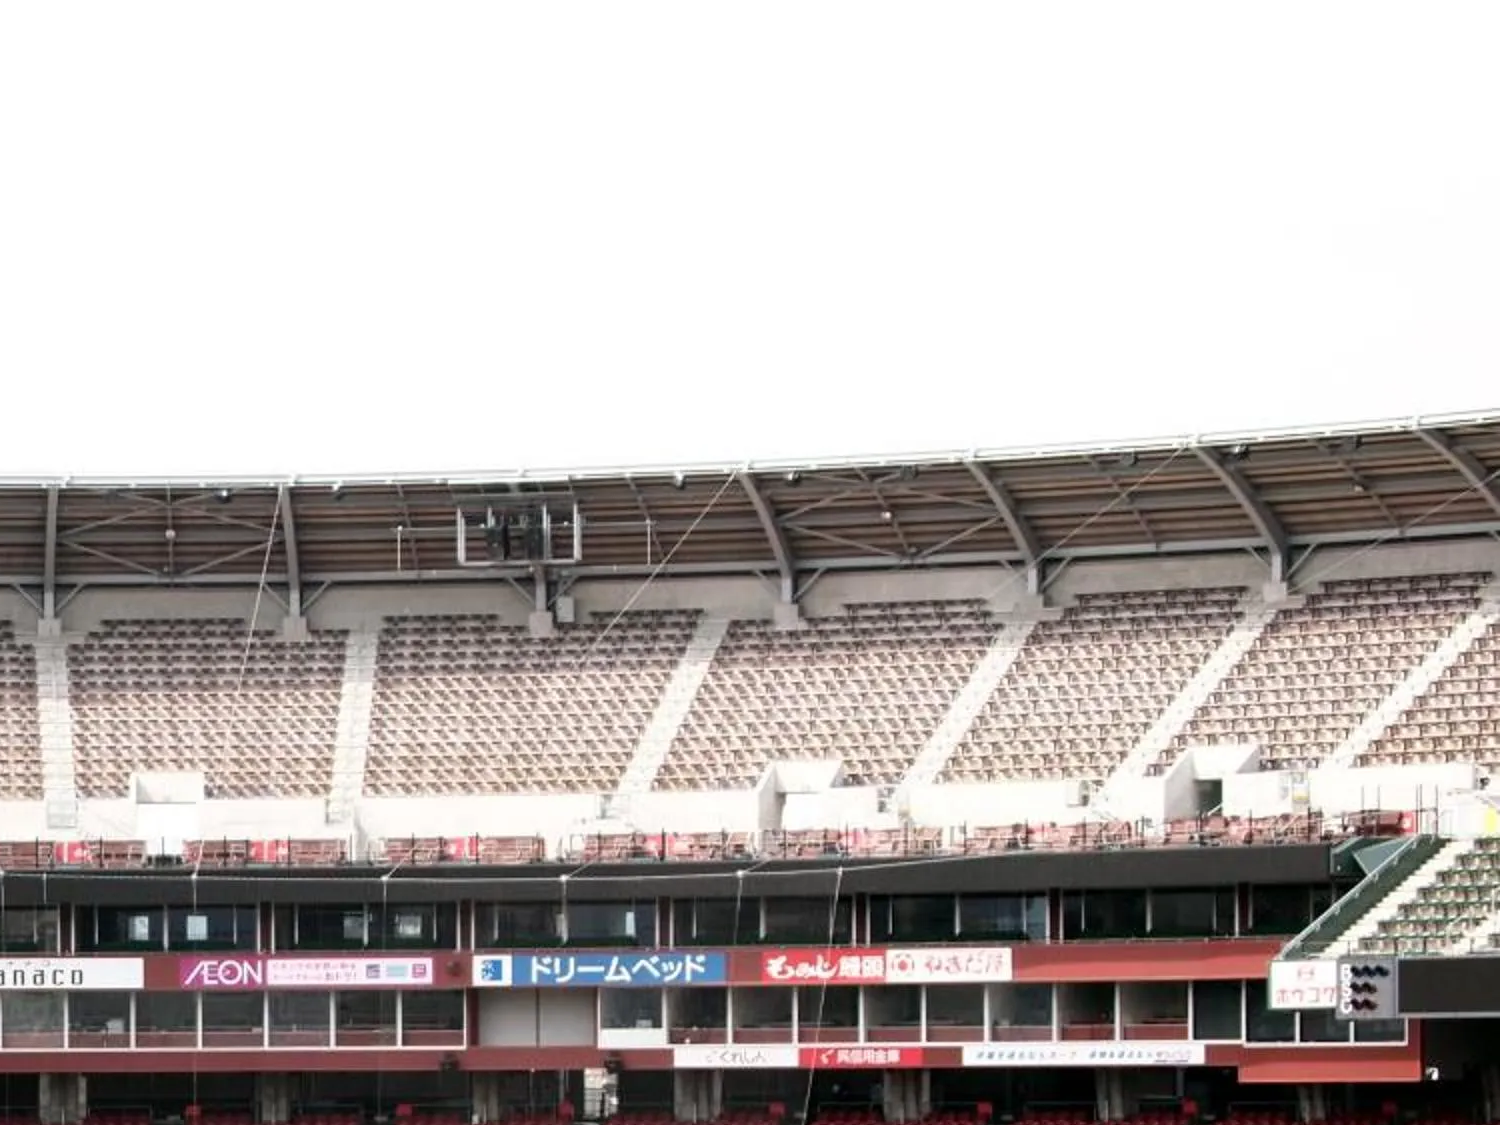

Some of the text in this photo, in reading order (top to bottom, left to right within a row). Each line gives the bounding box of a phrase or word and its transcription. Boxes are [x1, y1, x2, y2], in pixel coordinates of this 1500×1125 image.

[531, 954, 706, 983] ドリームベッド
